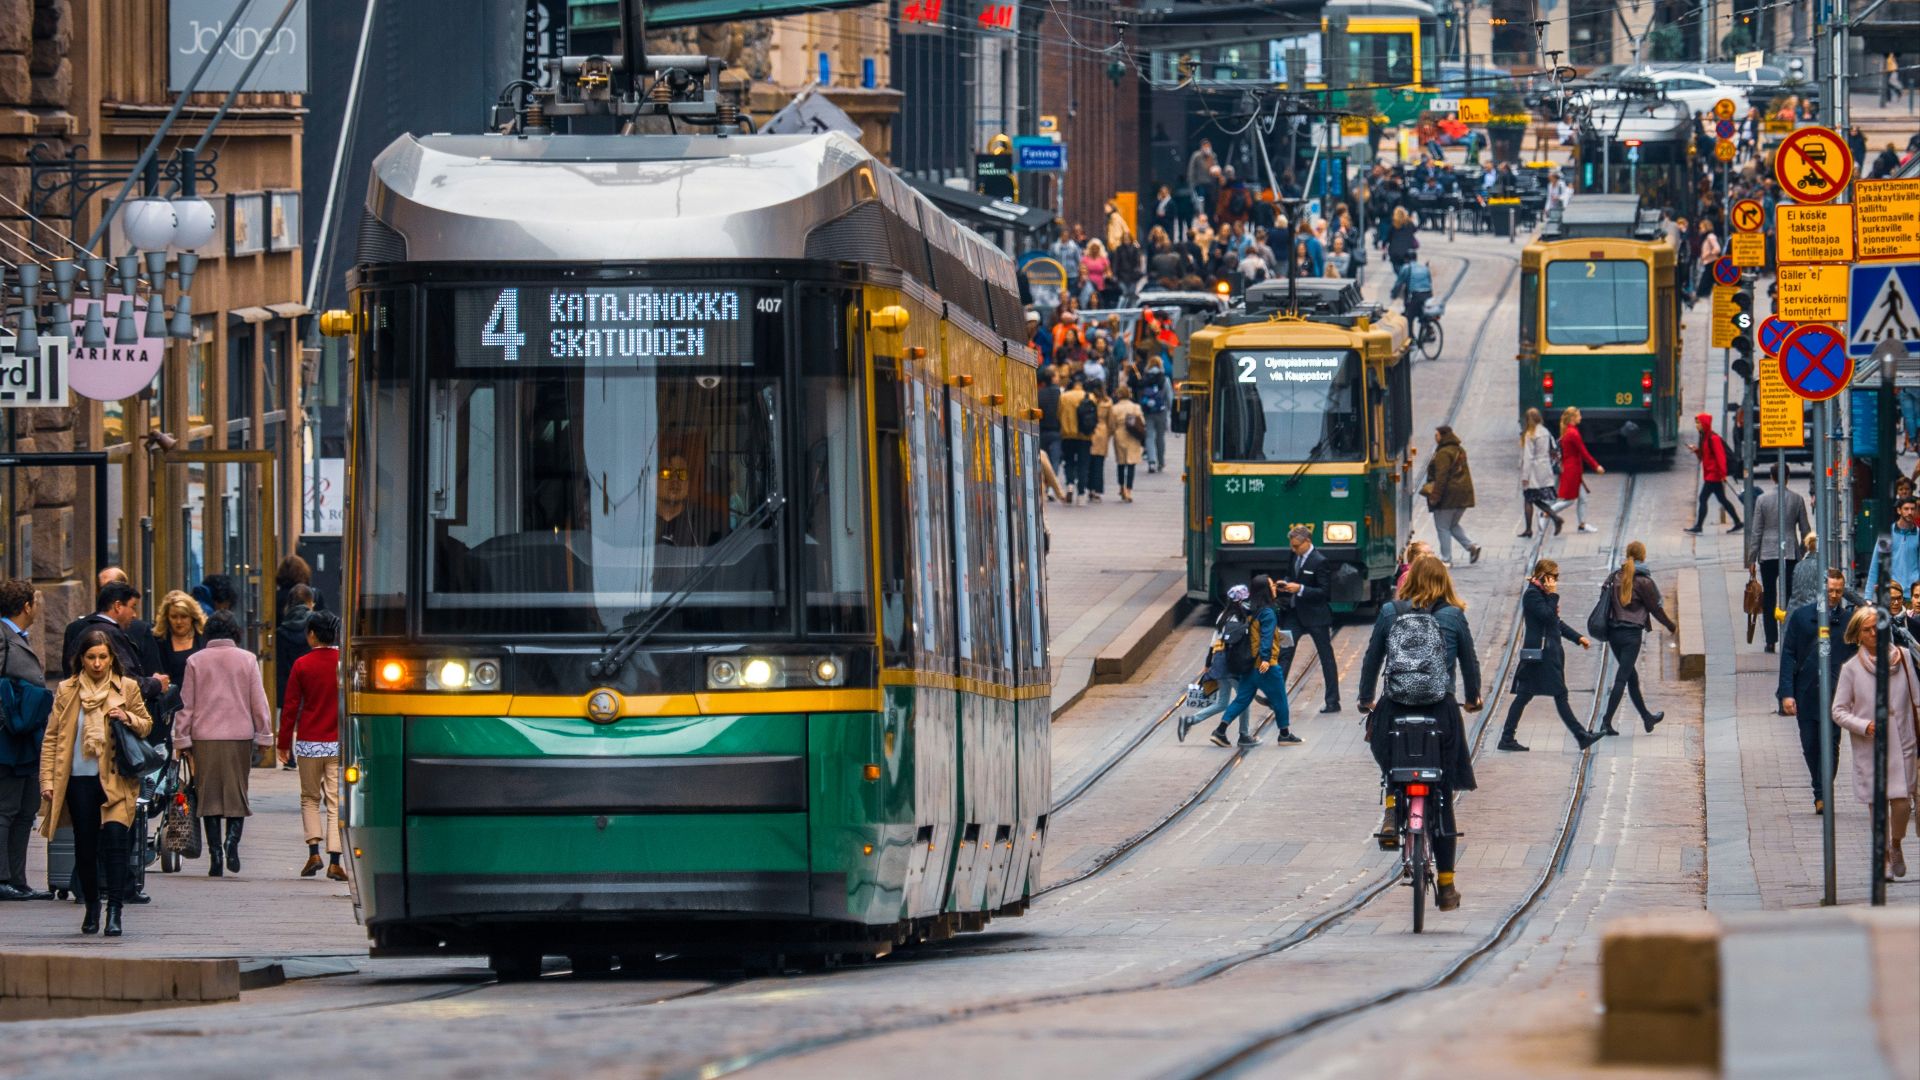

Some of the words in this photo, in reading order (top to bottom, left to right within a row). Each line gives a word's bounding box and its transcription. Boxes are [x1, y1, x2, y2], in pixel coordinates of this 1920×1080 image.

[179, 20, 296, 60] Jokinen
[526, 9, 536, 102] GLLERIA
[1787, 211, 1796, 220] Ei
[1800, 211, 1827, 220] koske
[1859, 204, 1887, 213] sallittu
[1863, 224, 1903, 234] purkaville
[1585, 262, 1597, 278] 2
[1780, 270, 1807, 280] Gäller
[550, 292, 739, 322] KATAJANOKKA
[756, 298, 782, 313] 407
[481, 288, 525, 361] 4
[1739, 313, 1751, 328] S
[550, 328, 704, 357] SKATUDDEN
[68, 347, 149, 361] ARIKKA
[1238, 356, 1257, 383] 2
[1269, 371, 1284, 381] via
[1284, 370, 1332, 382] Kauppatori
[1615, 392, 1633, 405] 89
